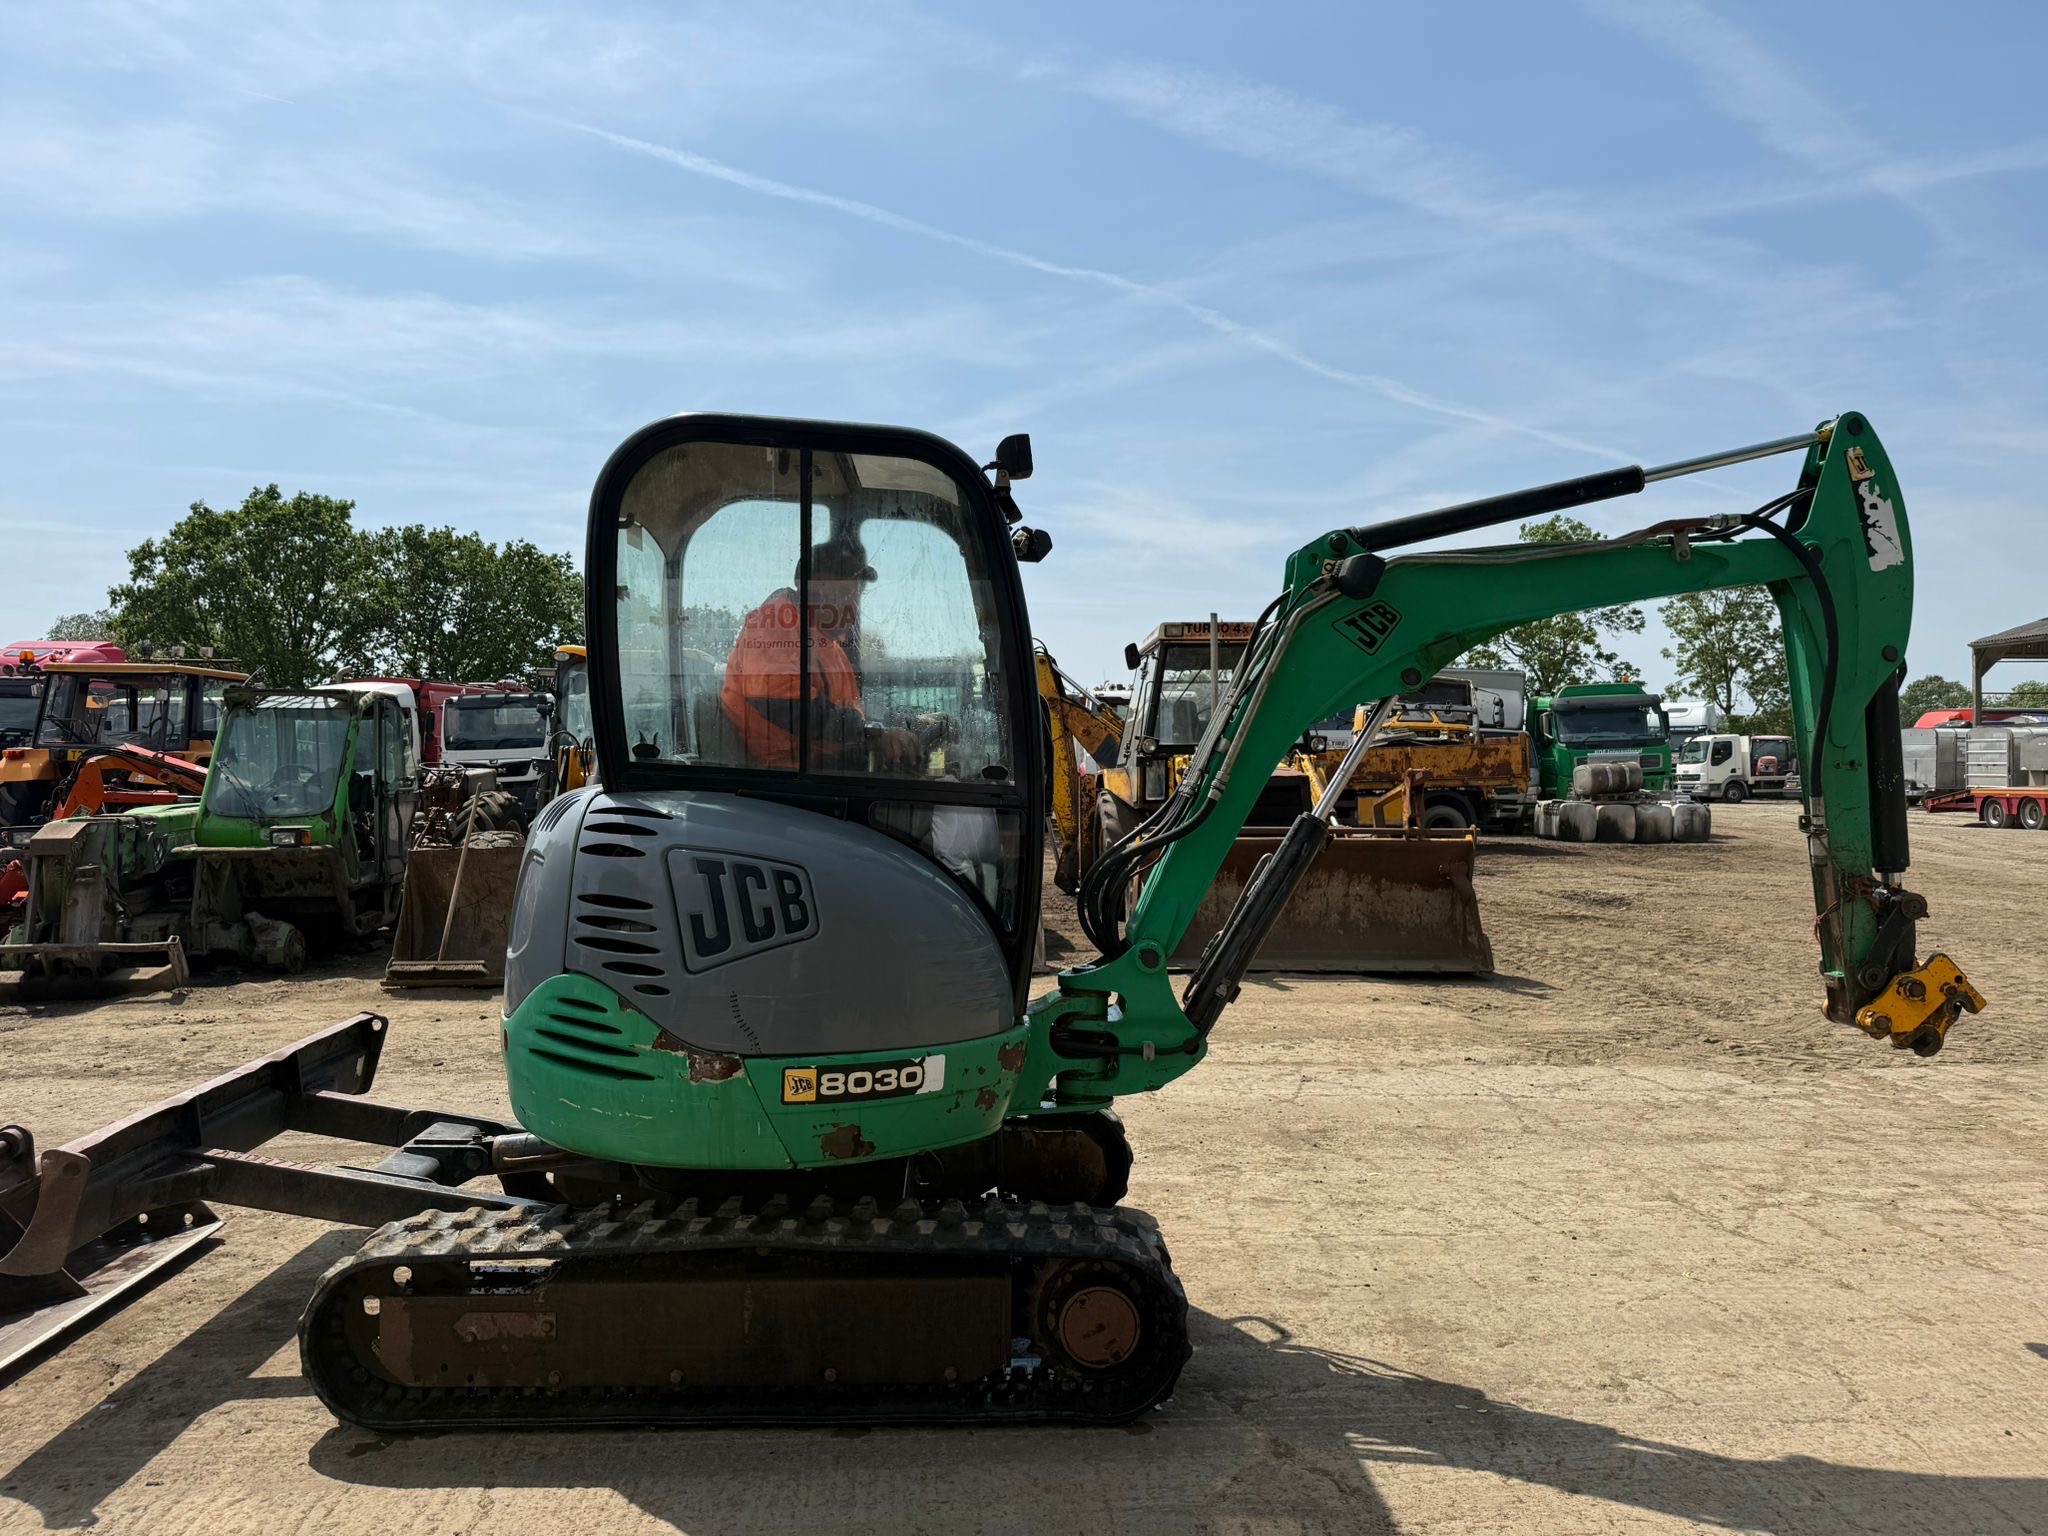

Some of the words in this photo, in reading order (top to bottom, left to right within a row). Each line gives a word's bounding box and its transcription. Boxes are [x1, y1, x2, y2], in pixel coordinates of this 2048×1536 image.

[1233, 623, 1255, 634] 4x
[1344, 604, 1398, 649] JCB
[690, 859, 810, 958] JCB
[791, 1077, 814, 1094] JCB
[820, 1065, 924, 1096] 8030
